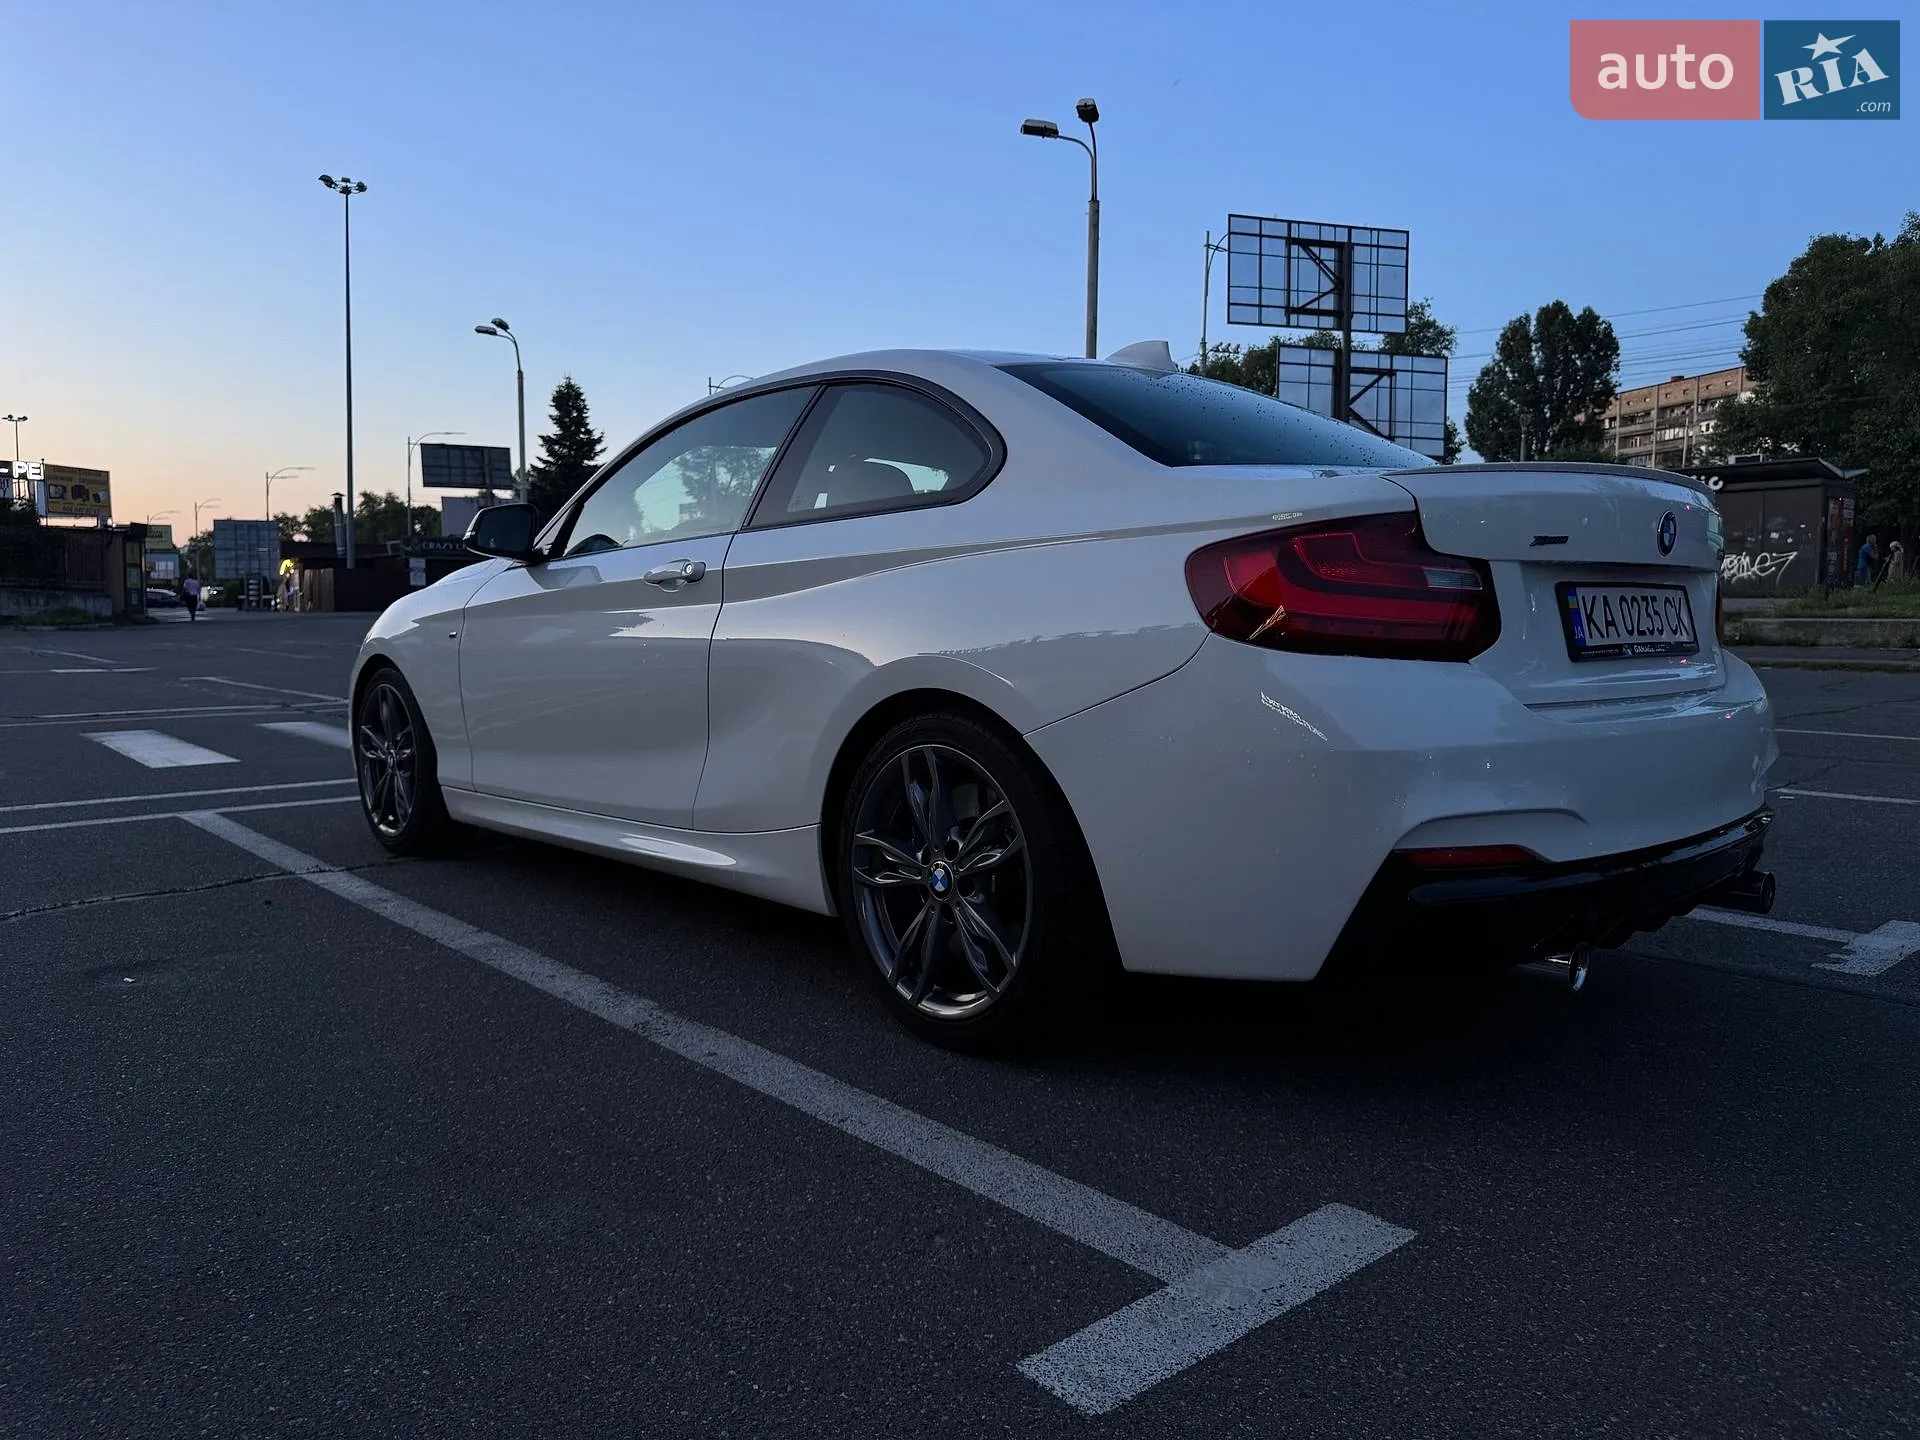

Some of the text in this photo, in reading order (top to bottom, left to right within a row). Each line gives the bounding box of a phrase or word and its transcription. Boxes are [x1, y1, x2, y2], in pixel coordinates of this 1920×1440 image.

[1581, 594, 1690, 639] KA 0235 CK
